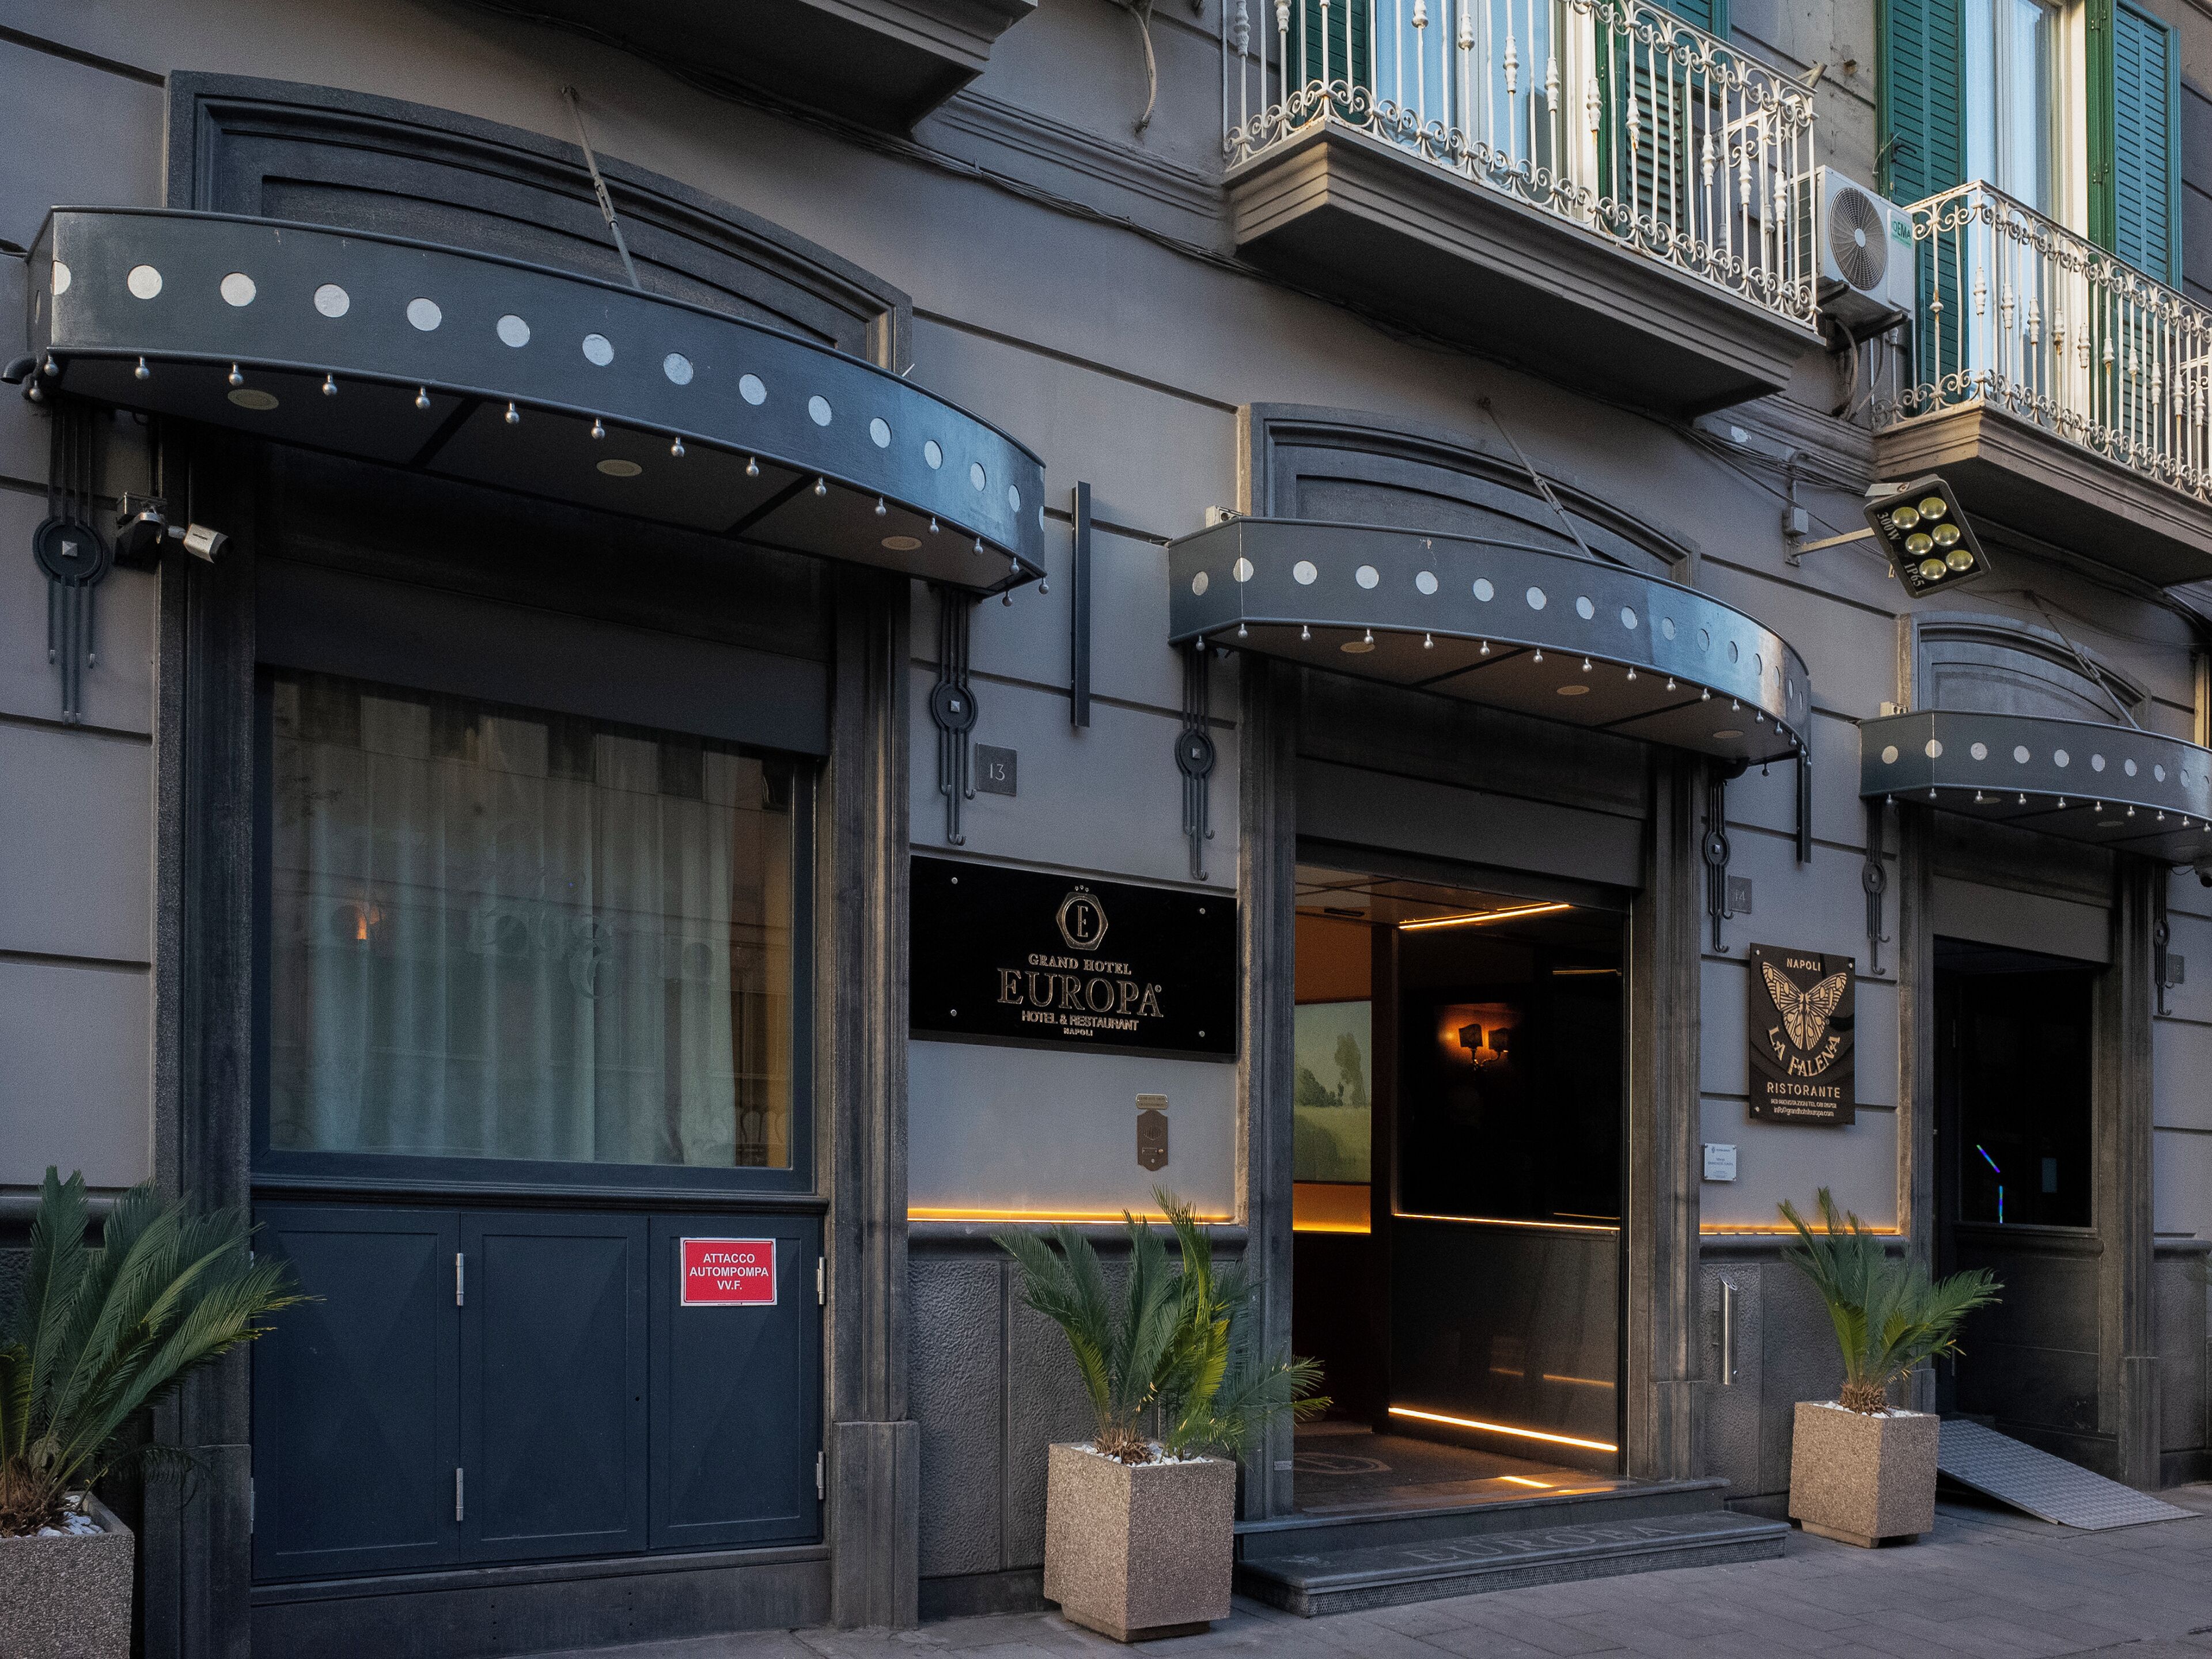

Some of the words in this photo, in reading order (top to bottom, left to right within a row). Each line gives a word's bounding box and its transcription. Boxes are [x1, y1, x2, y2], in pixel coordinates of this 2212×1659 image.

[1877, 512, 1901, 540] 300W
[1904, 562, 1925, 586] IP65
[990, 763, 1005, 781] 13
[1734, 889, 1746, 903] 14
[1077, 905, 1089, 938] E
[1028, 953, 1079, 969] GRAND
[1084, 959, 1132, 975] HOTEL
[1786, 957, 1821, 972] NAPOLI
[1021, 1010, 1058, 1024] HOTEL
[1059, 1014, 1067, 1025] &
[1069, 1014, 1139, 1031] RESTAURANT
[1063, 1027, 1093, 1036] NAPOLI
[1767, 1025, 1785, 1061] LA
[1787, 1036, 1840, 1077] FALENA
[1767, 1081, 1840, 1099] RISTORANTE
[703, 1253, 755, 1263] ATTACCO
[690, 1267, 769, 1277] AUTOMPOMPA
[717, 1280, 743, 1290] VV.F.
